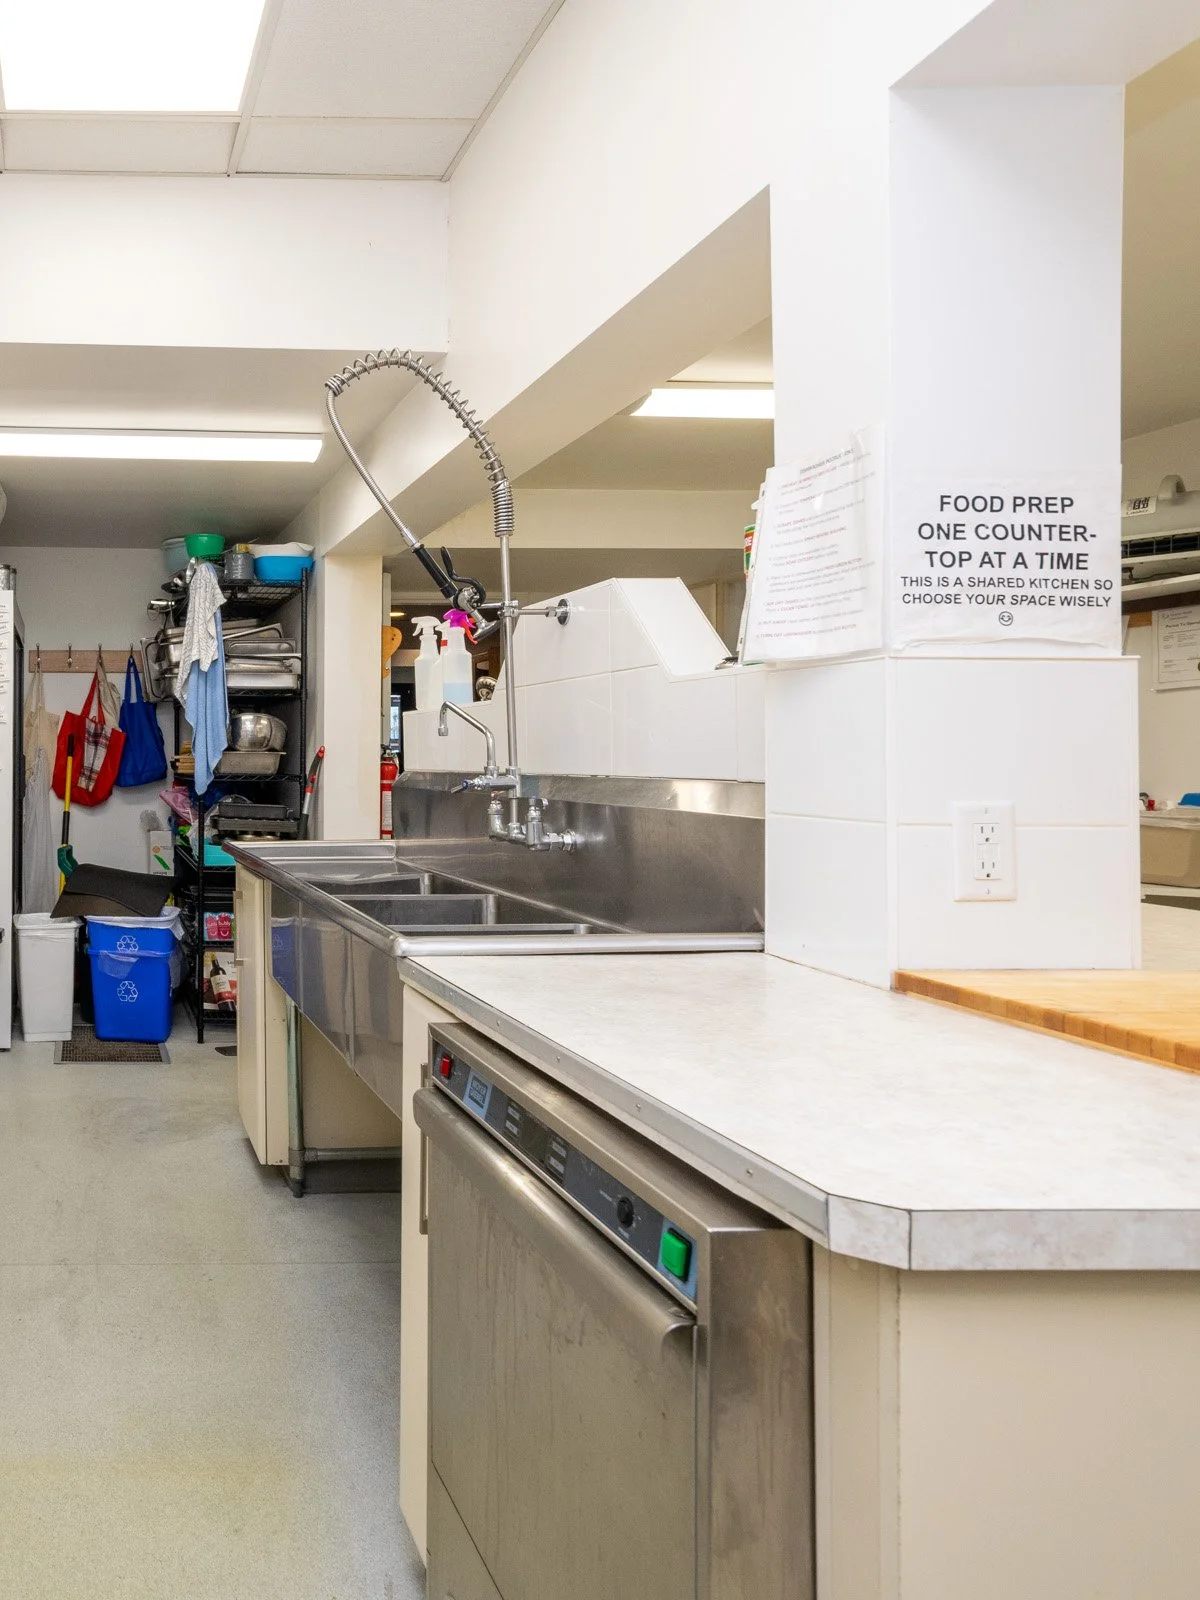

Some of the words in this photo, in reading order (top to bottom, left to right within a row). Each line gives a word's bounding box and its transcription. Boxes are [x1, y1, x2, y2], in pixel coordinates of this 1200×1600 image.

[940, 495, 1004, 512] FOOD
[1013, 496, 1074, 513] PREP
[918, 523, 966, 540] ONE
[975, 524, 1096, 542] COUNTER-
[925, 551, 972, 568] TOP
[979, 552, 1006, 568] AT
[1013, 552, 1028, 569] A
[1035, 552, 1088, 570] TIME
[901, 577, 932, 586] THIS
[938, 577, 949, 587] IS
[954, 577, 963, 587] A
[968, 577, 1025, 588] SHARED
[1029, 579, 1089, 589] KITCHEN
[1094, 579, 1113, 590] SO
[903, 594, 961, 604] CHOOSE
[966, 594, 1005, 605] YOUR
[1011, 595, 1055, 606] SPACE
[1060, 596, 1111, 607] WISELY
